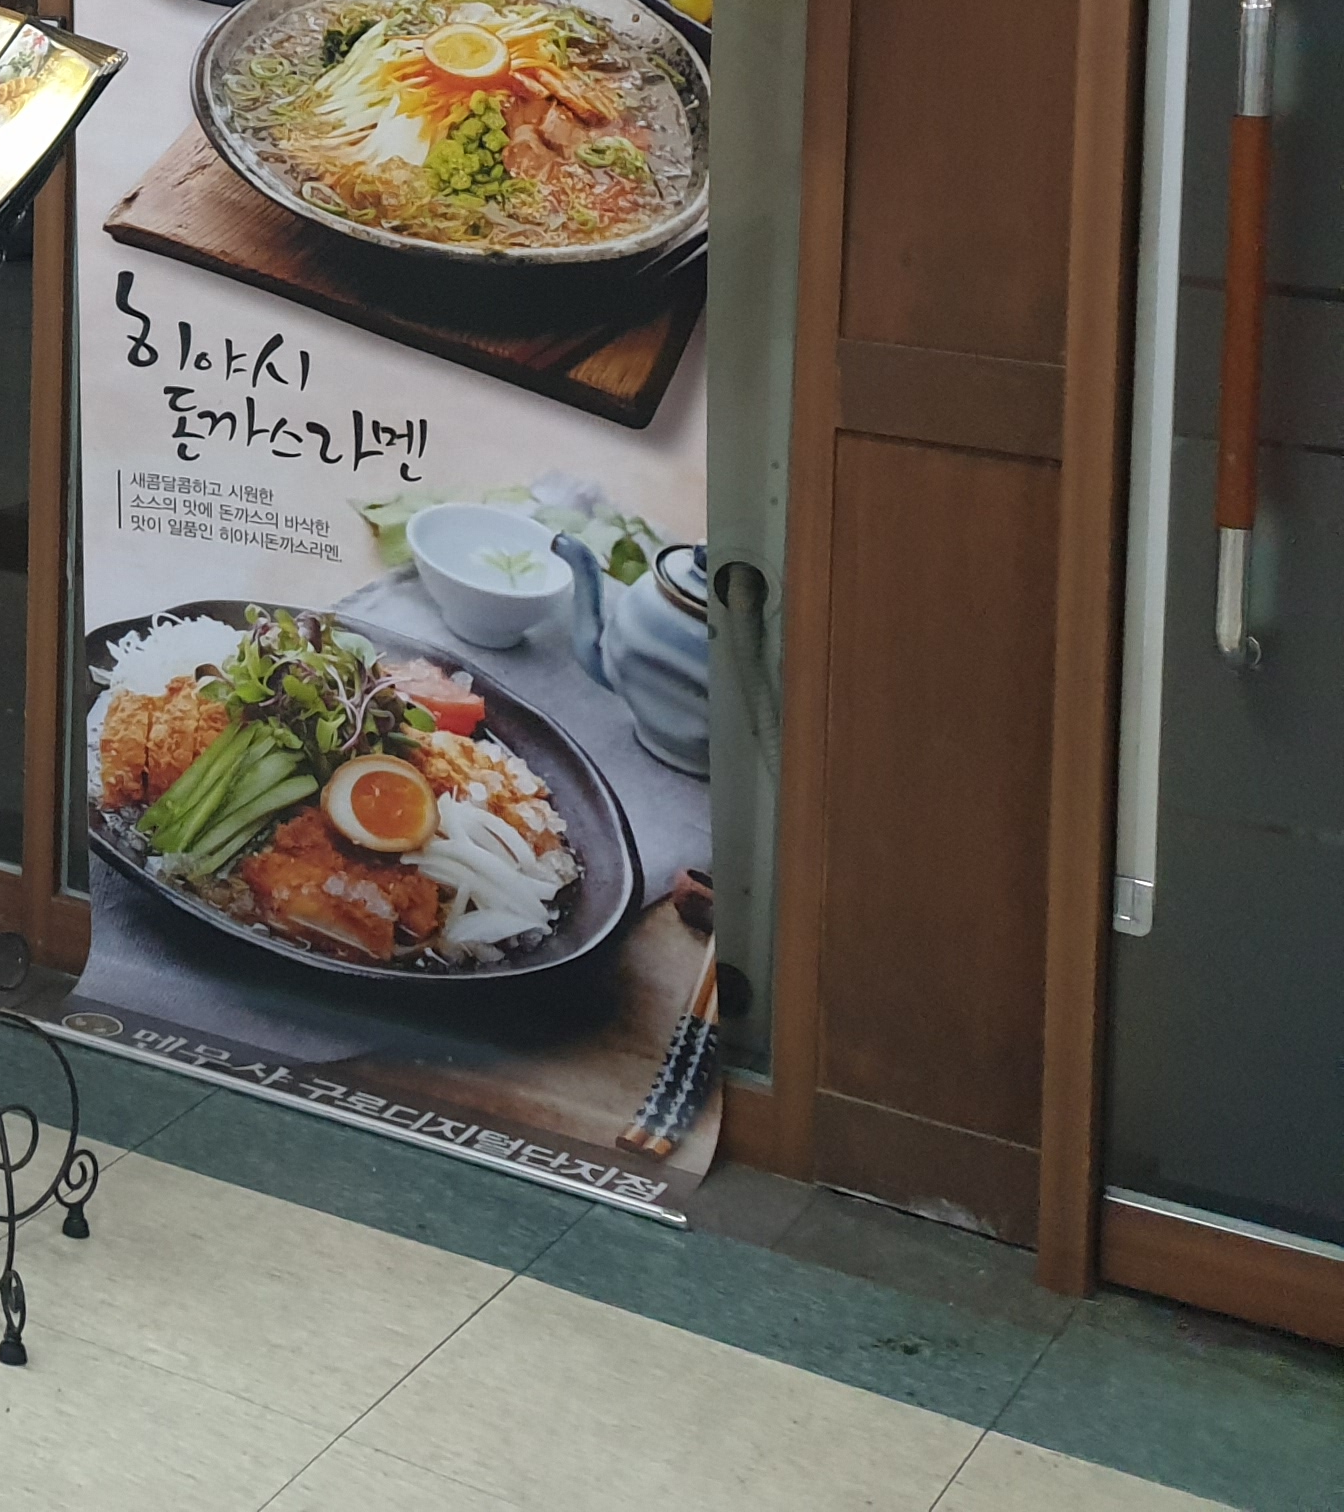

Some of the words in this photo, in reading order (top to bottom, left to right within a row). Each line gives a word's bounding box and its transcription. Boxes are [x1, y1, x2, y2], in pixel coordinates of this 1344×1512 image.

[115, 270, 310, 392] 히야시
[163, 385, 429, 483] 돈까스라멘
[130, 471, 223, 498] 새콤달콤하고
[228, 484, 275, 507] 시원한
[130, 493, 177, 515] 소스의
[182, 499, 213, 519] 맛에
[218, 503, 279, 529] 돈까스의
[284, 515, 331, 539] 바삭한
[130, 514, 162, 534] 맛이
[167, 518, 214, 541] 일품인
[298, 1076, 670, 1205] 구로디지털단지점
